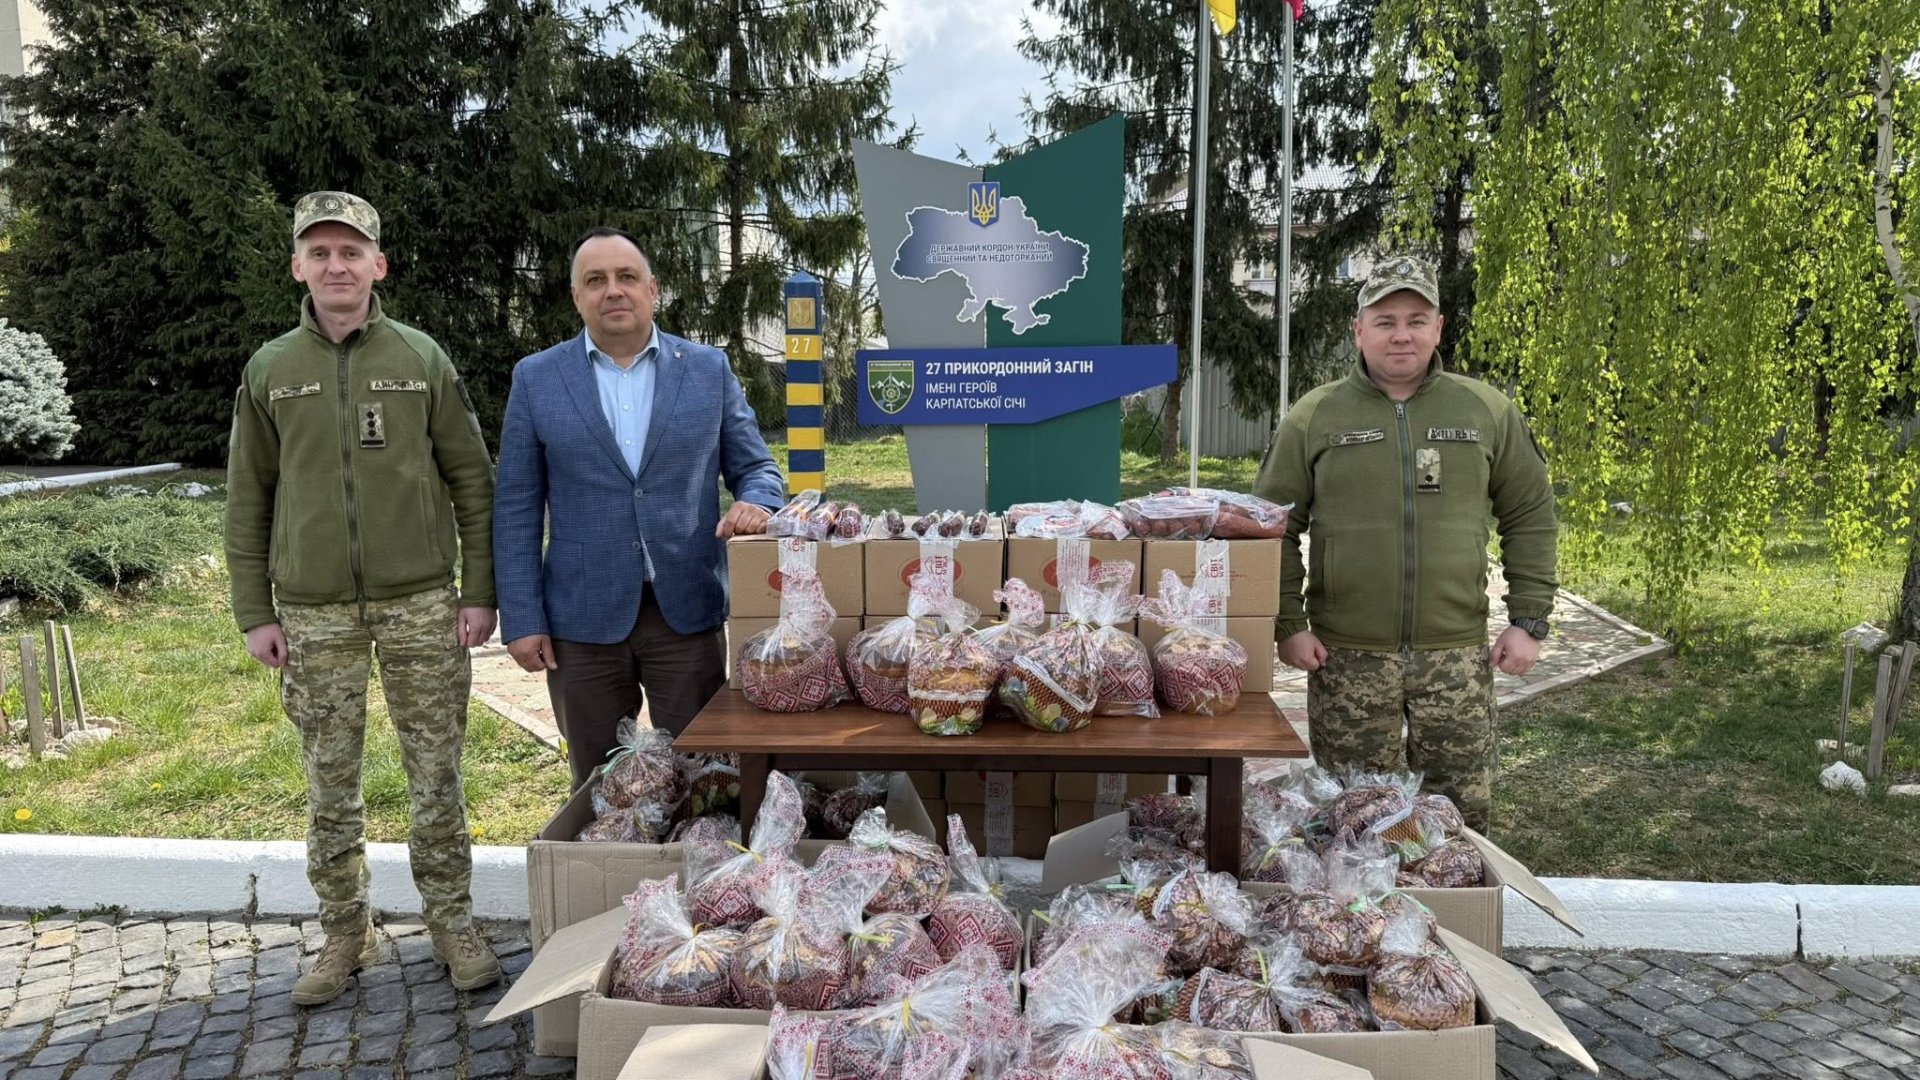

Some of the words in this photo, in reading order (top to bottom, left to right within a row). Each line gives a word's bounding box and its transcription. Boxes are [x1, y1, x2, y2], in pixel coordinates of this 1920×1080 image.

[930, 242, 981, 254] ДЕРЖАВНИЙ
[982, 243, 1014, 253] КОРДОН
[1015, 242, 1050, 252] УКРАЇНИ
[926, 253, 976, 264] СВЯЩЕННИЙ
[977, 254, 987, 262] ТА
[989, 251, 1054, 263] НЕДОТОРКАНИЙ
[792, 338, 810, 353] 27
[926, 362, 940, 375] 27
[944, 358, 1052, 376] ПРИКОРДОННИЙ
[1055, 360, 1094, 373] ЗАГІН
[925, 382, 956, 394] ІМЕНІ
[959, 380, 998, 393] ГЕРОЇВ
[925, 395, 1002, 409] КАРПАТСЬКОЇ
[1004, 397, 1026, 409] СІЧІ
